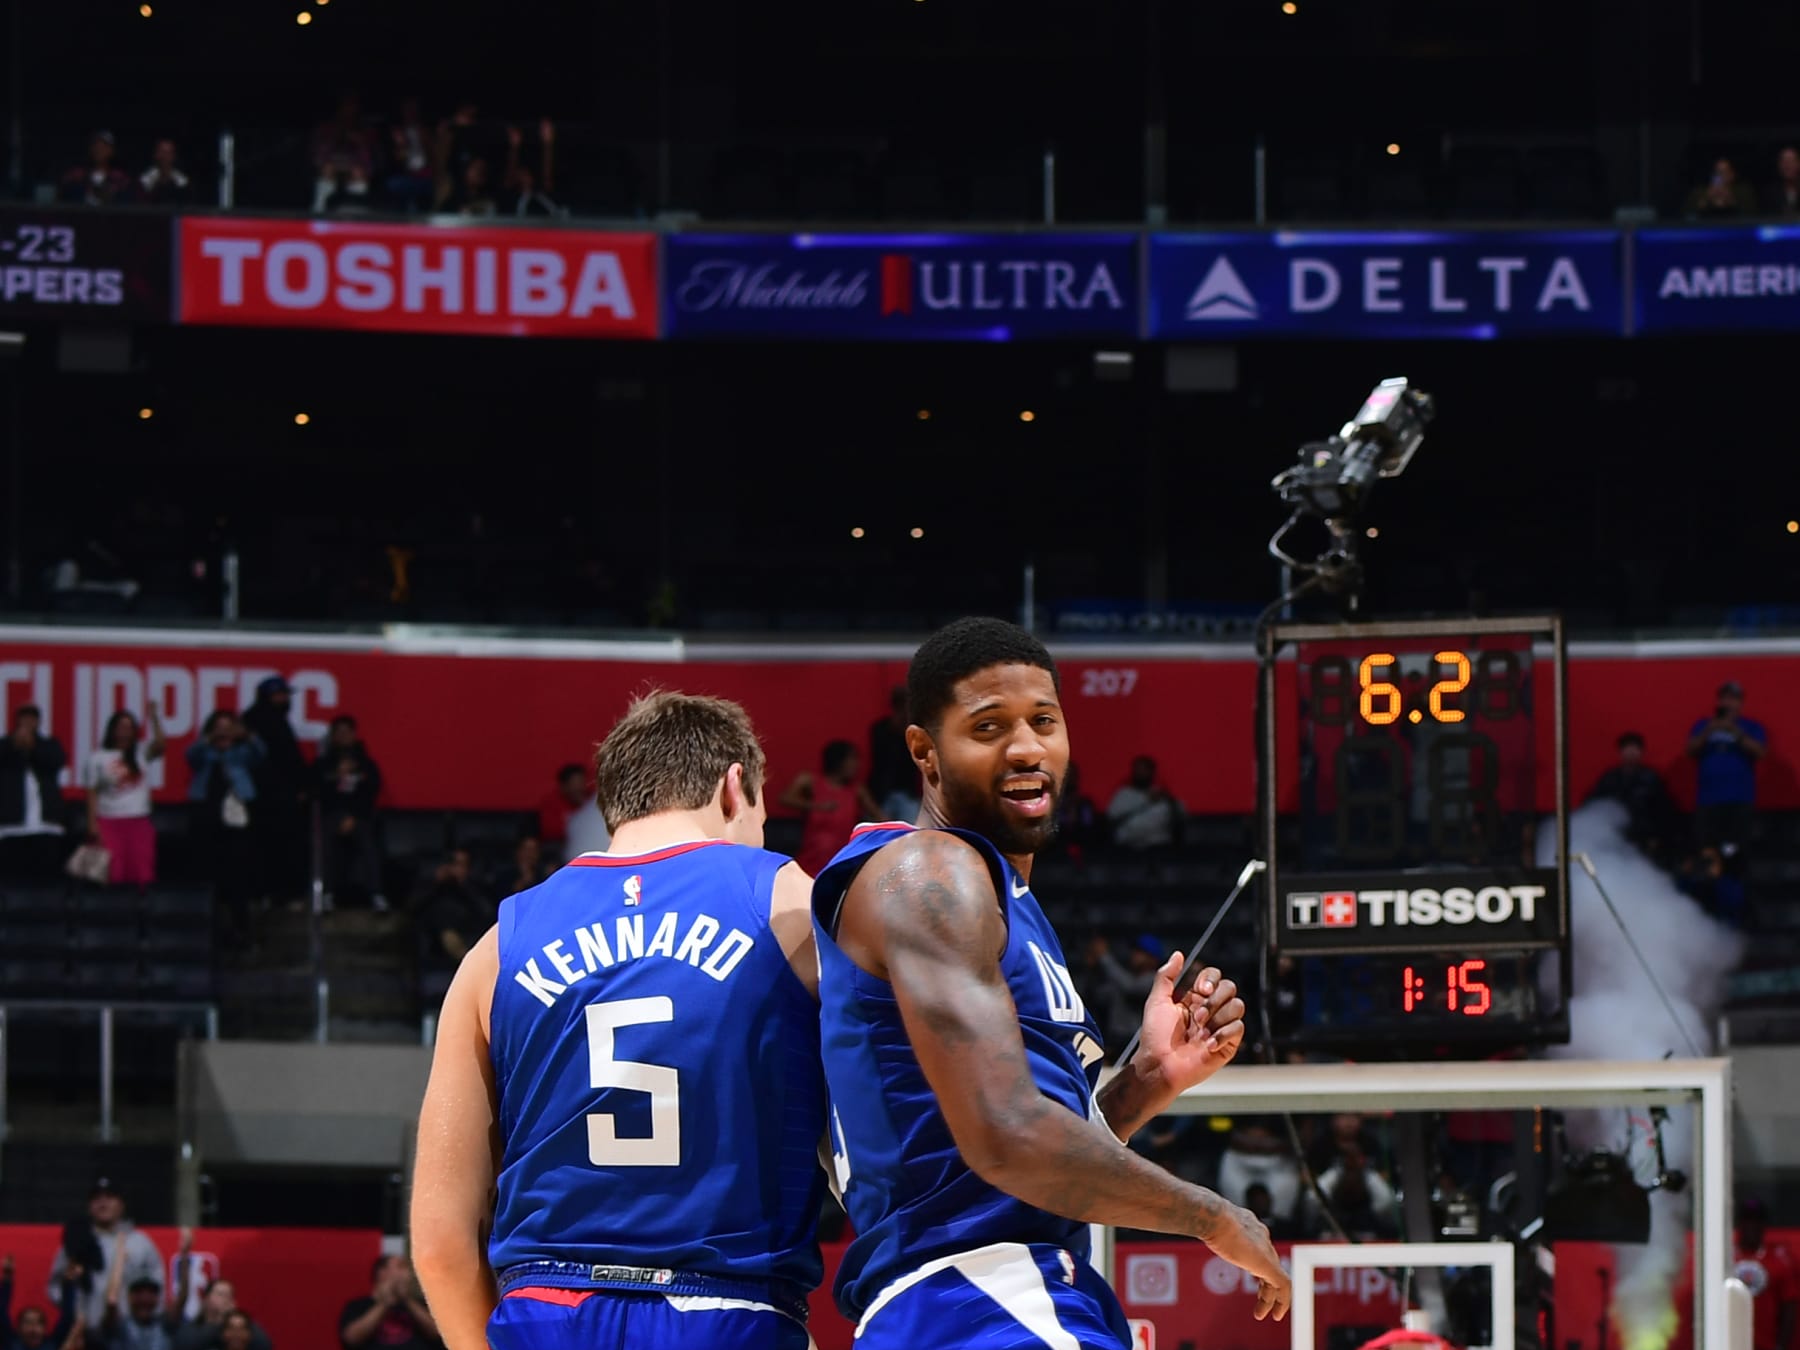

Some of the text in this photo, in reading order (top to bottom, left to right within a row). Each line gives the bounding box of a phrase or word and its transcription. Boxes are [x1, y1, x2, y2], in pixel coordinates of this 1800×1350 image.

[202, 238, 635, 318] TOSHIBA
[921, 261, 1123, 309] ULTRA
[1290, 257, 1590, 311] DELTA
[1658, 263, 1800, 299] AMERI
[1081, 668, 1138, 697] 207
[1359, 651, 1471, 724] 6.2
[1358, 886, 1546, 926] TISSOT
[514, 911, 754, 1008] KENNARD
[585, 995, 680, 1166] 5
